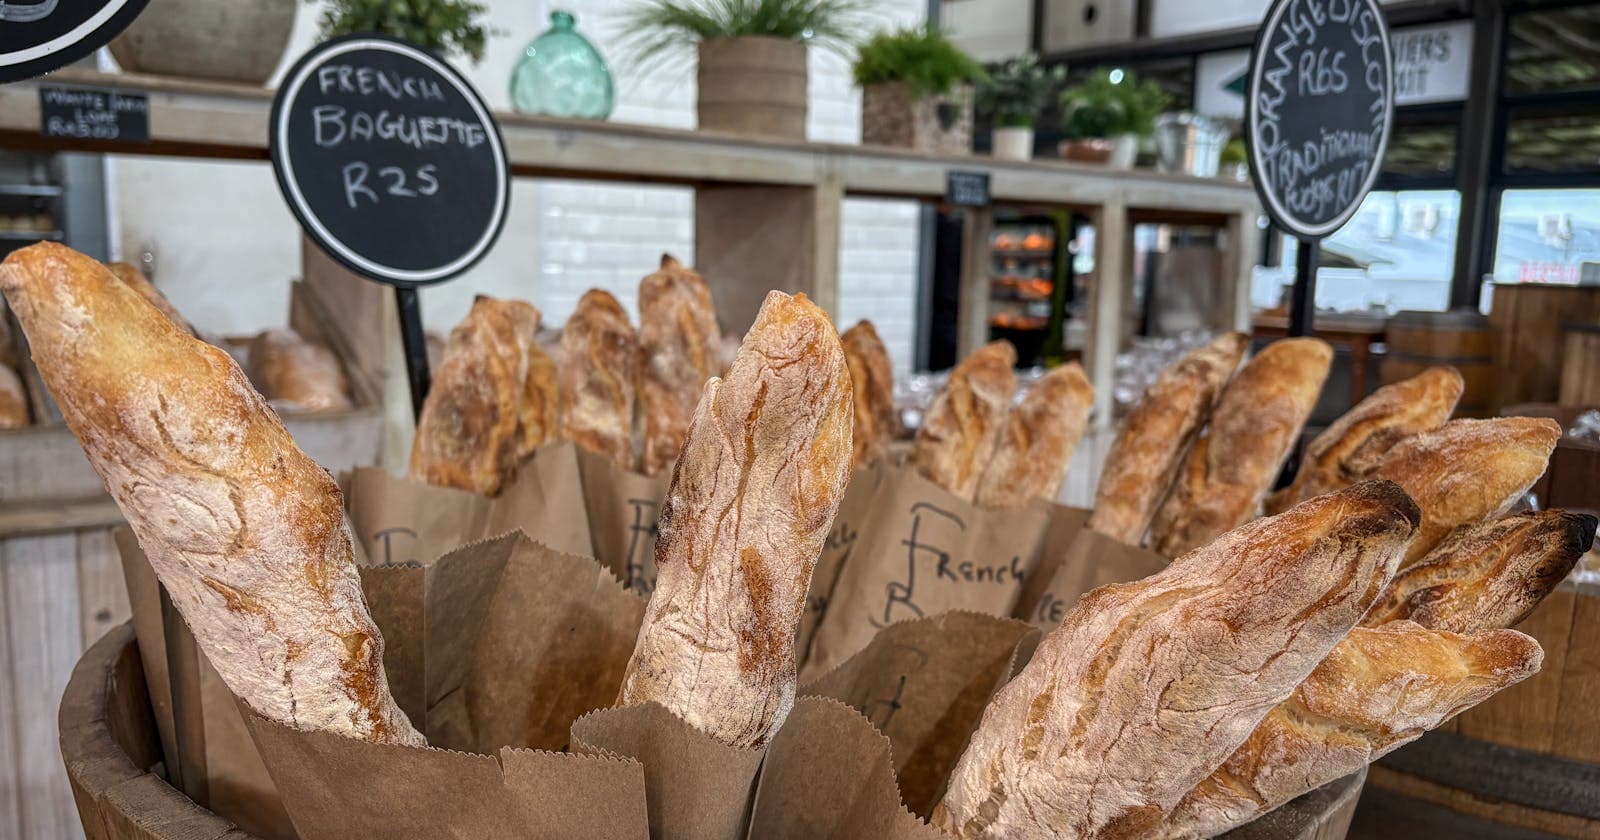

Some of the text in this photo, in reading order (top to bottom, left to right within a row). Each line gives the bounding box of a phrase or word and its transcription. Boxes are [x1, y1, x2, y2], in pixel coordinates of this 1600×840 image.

[1391, 30, 1452, 65] IERS
[317, 64, 445, 101] FRENCH
[1298, 46, 1349, 97] R65
[312, 104, 486, 149] BAGUETTE
[341, 161, 440, 209] R25
